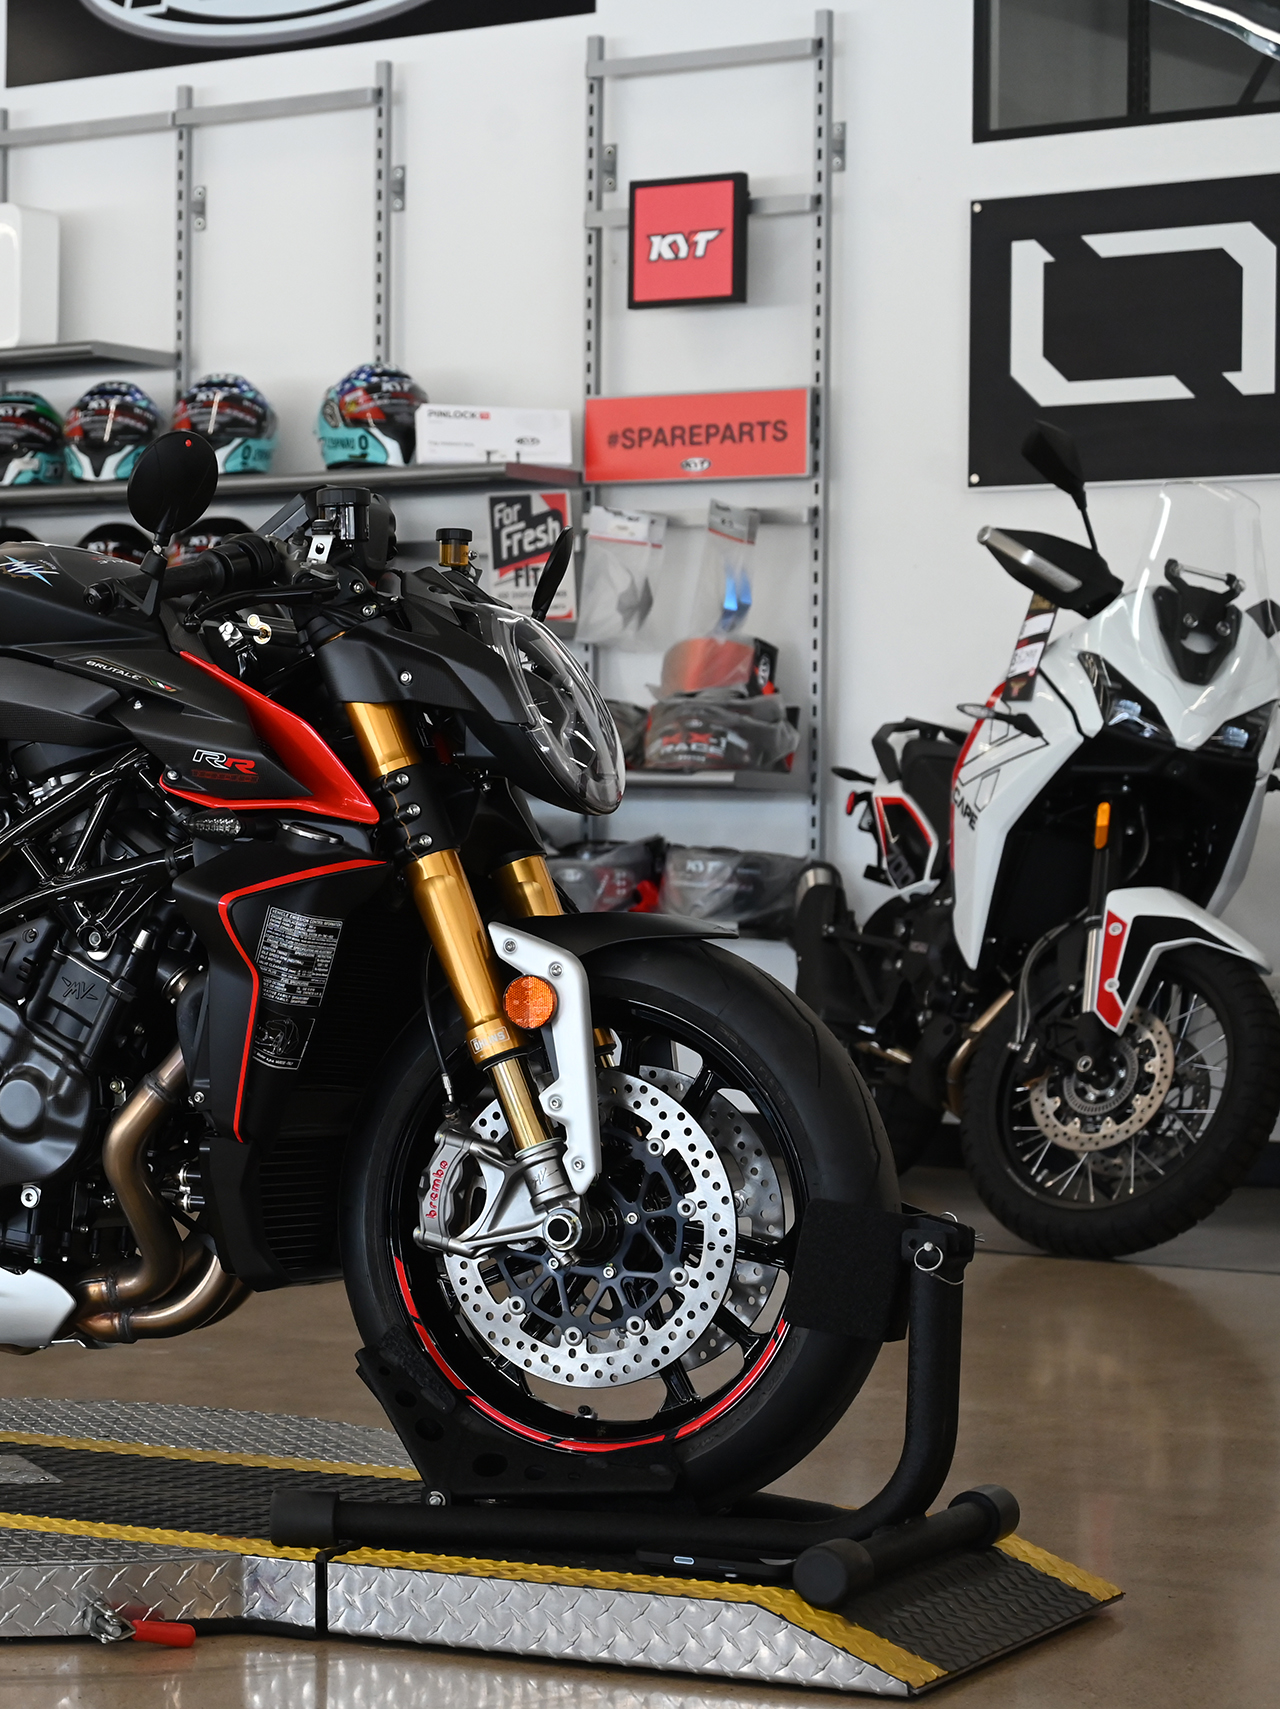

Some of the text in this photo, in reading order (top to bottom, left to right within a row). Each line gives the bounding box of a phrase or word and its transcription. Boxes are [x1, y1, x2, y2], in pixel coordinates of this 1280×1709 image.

[647, 227, 724, 262] KYT
[607, 419, 789, 450] #SPAREPARTS
[493, 502, 522, 529] For
[501, 516, 560, 560] Fresh
[86, 660, 141, 681] BRUTALE
[192, 749, 258, 775] RR
[426, 1160, 448, 1218] brembo
